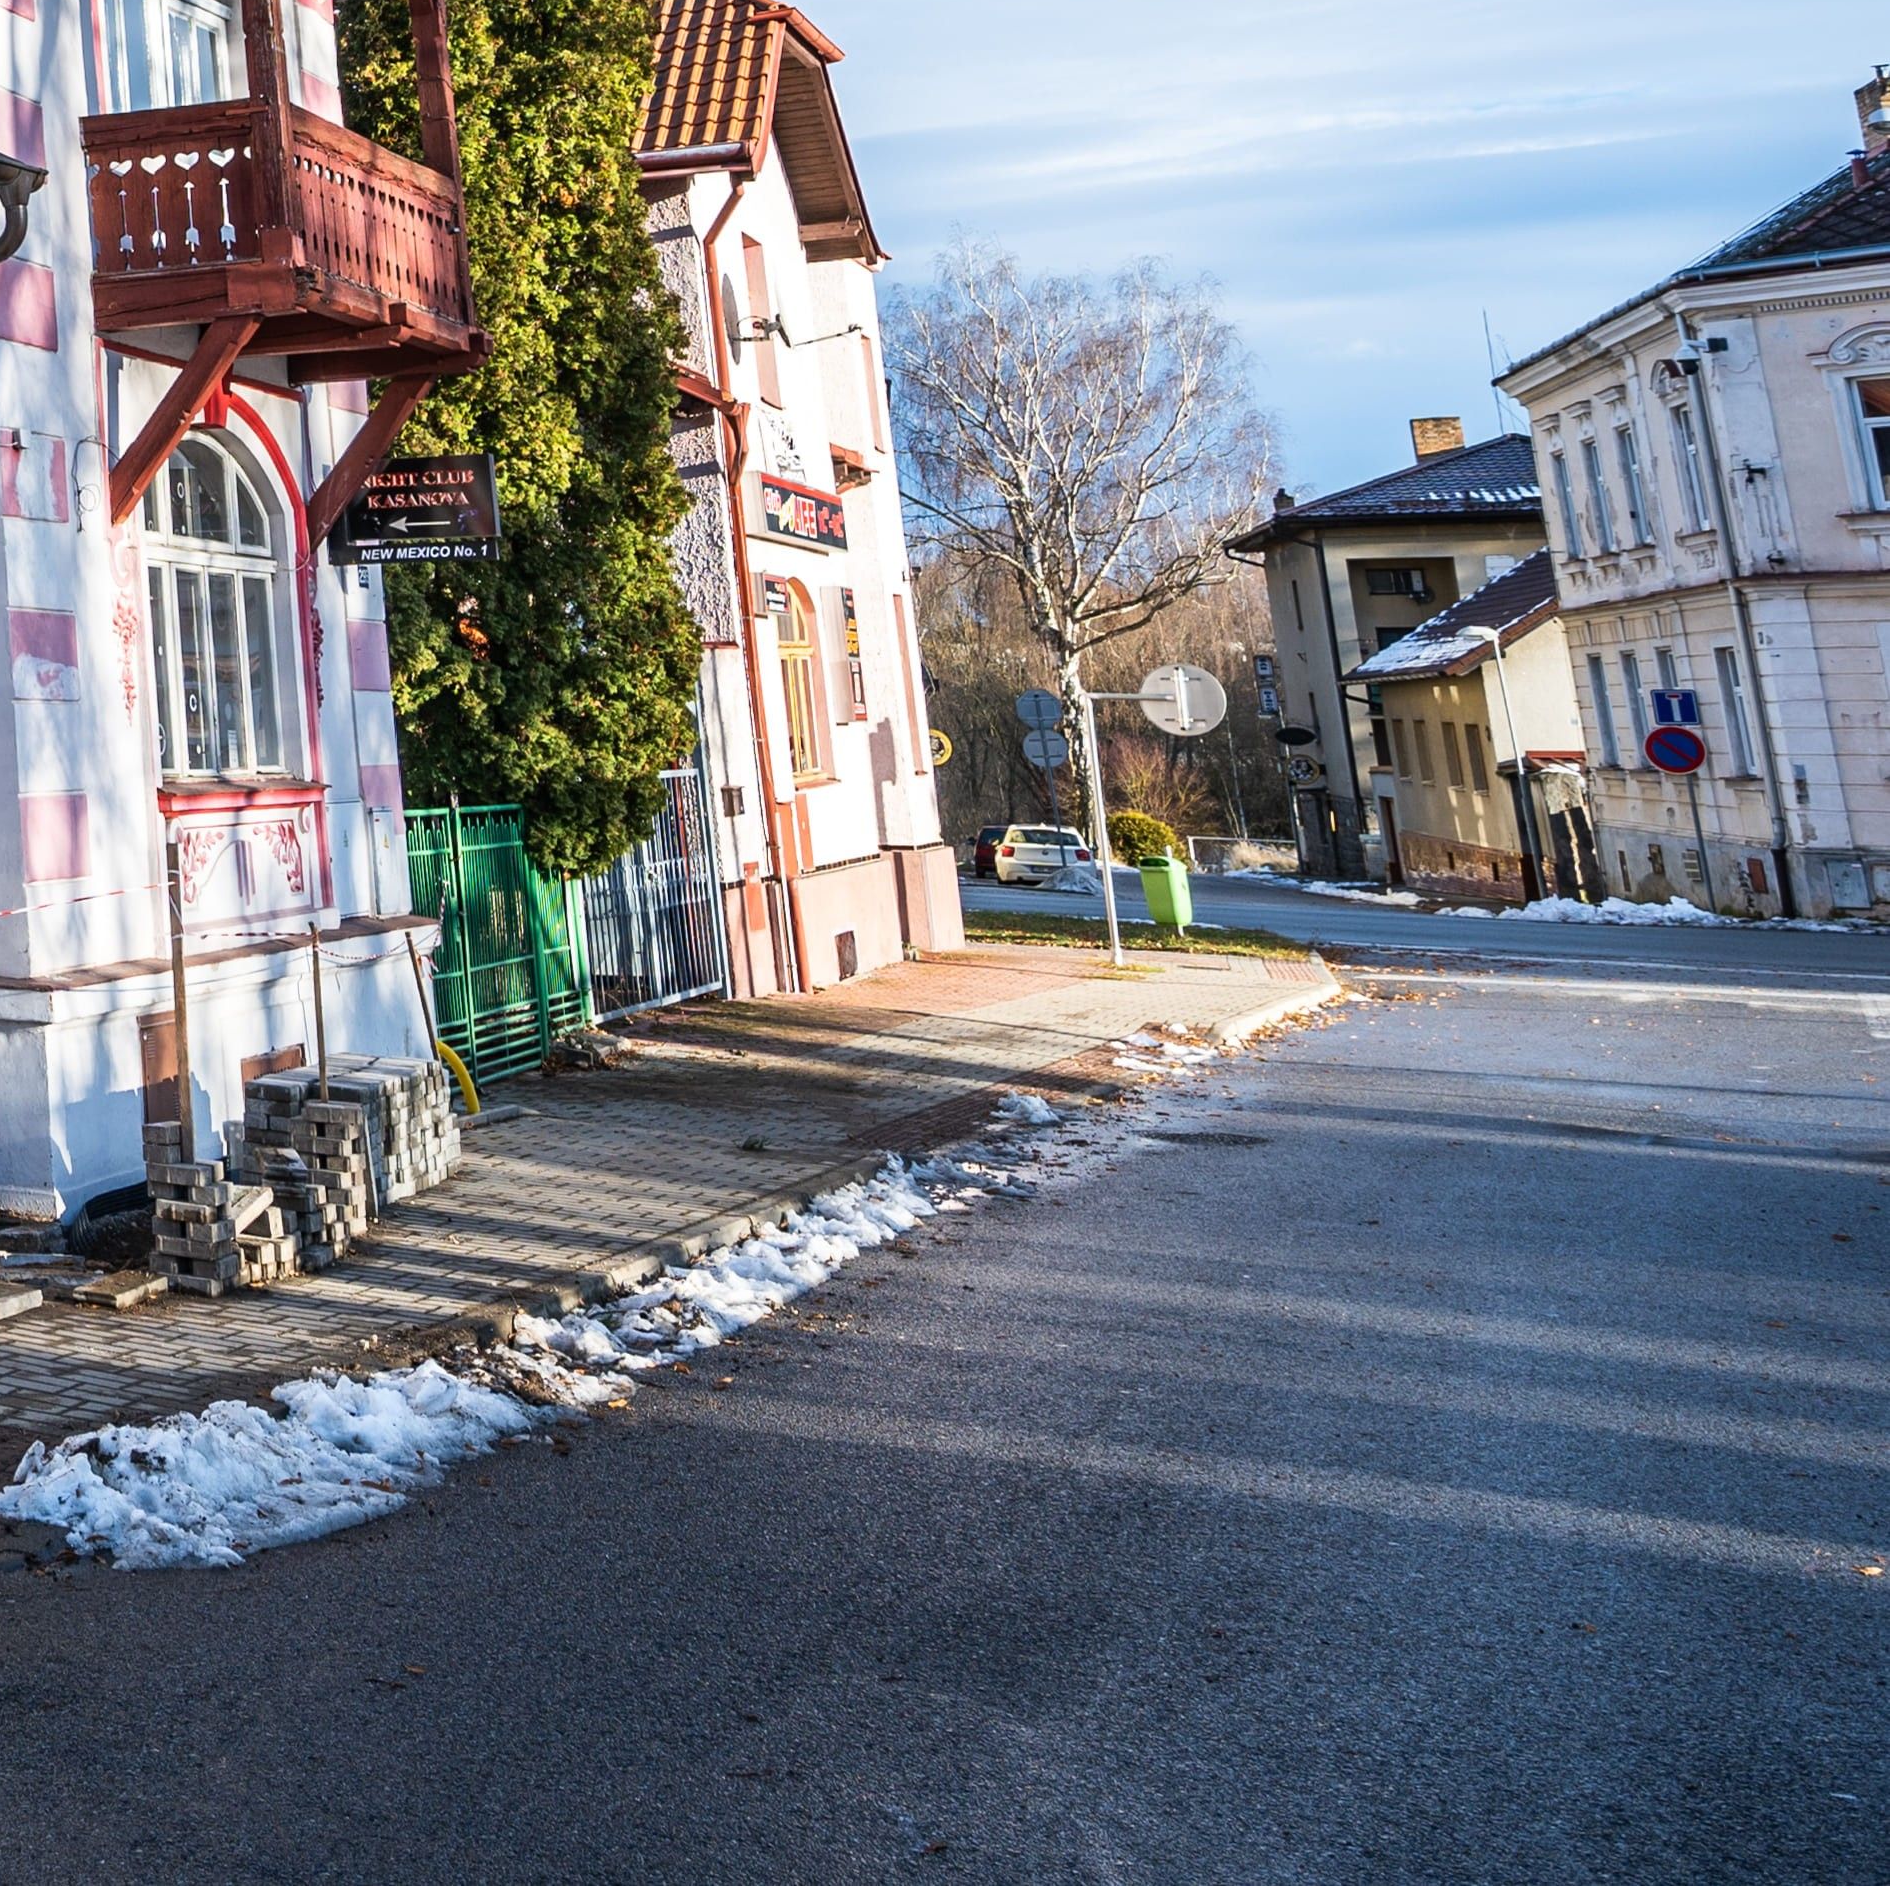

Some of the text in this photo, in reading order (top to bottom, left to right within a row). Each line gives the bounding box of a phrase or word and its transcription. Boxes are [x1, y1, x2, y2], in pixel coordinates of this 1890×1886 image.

[423, 469, 474, 486] CLUB
[367, 491, 469, 509] KASANOVA
[361, 544, 488, 561] NEW MEXICO No. 1
